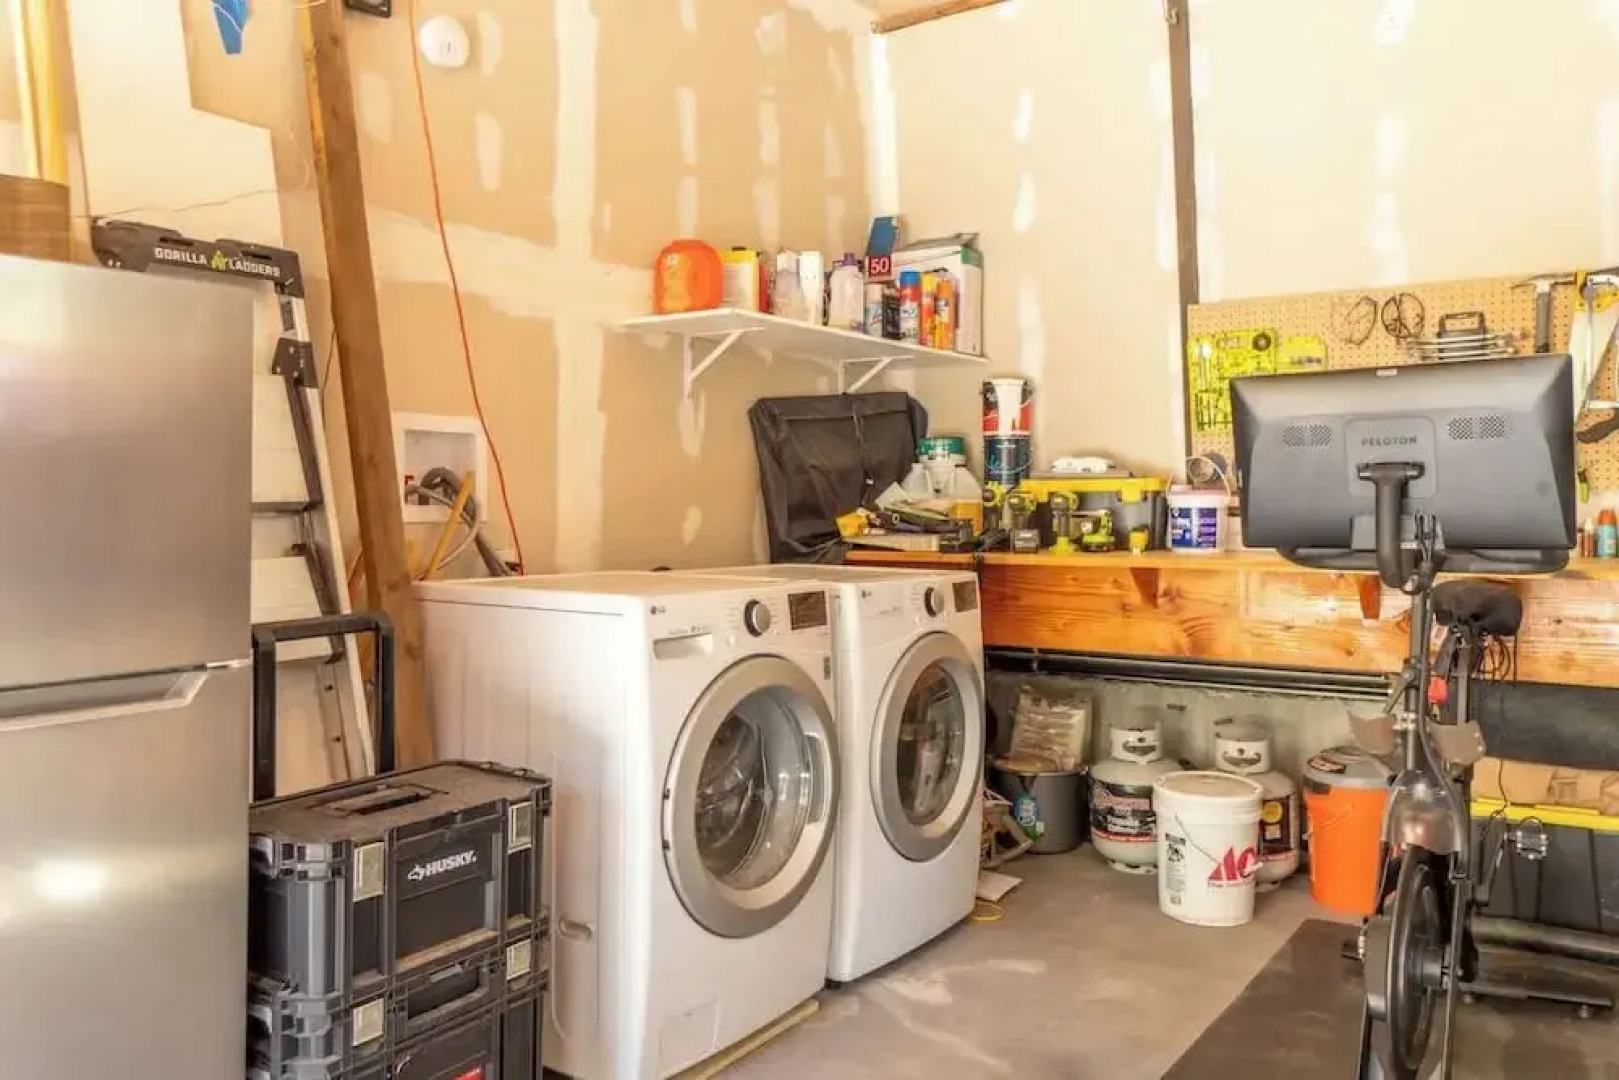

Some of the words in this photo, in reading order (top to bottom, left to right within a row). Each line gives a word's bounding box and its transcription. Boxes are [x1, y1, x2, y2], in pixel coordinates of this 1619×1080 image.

[154, 247, 207, 265] GORILLA
[229, 258, 281, 277] LADDERS
[870, 257, 890, 274] 50
[1361, 436, 1418, 446] PELOTON
[1208, 845, 1256, 881] AC
